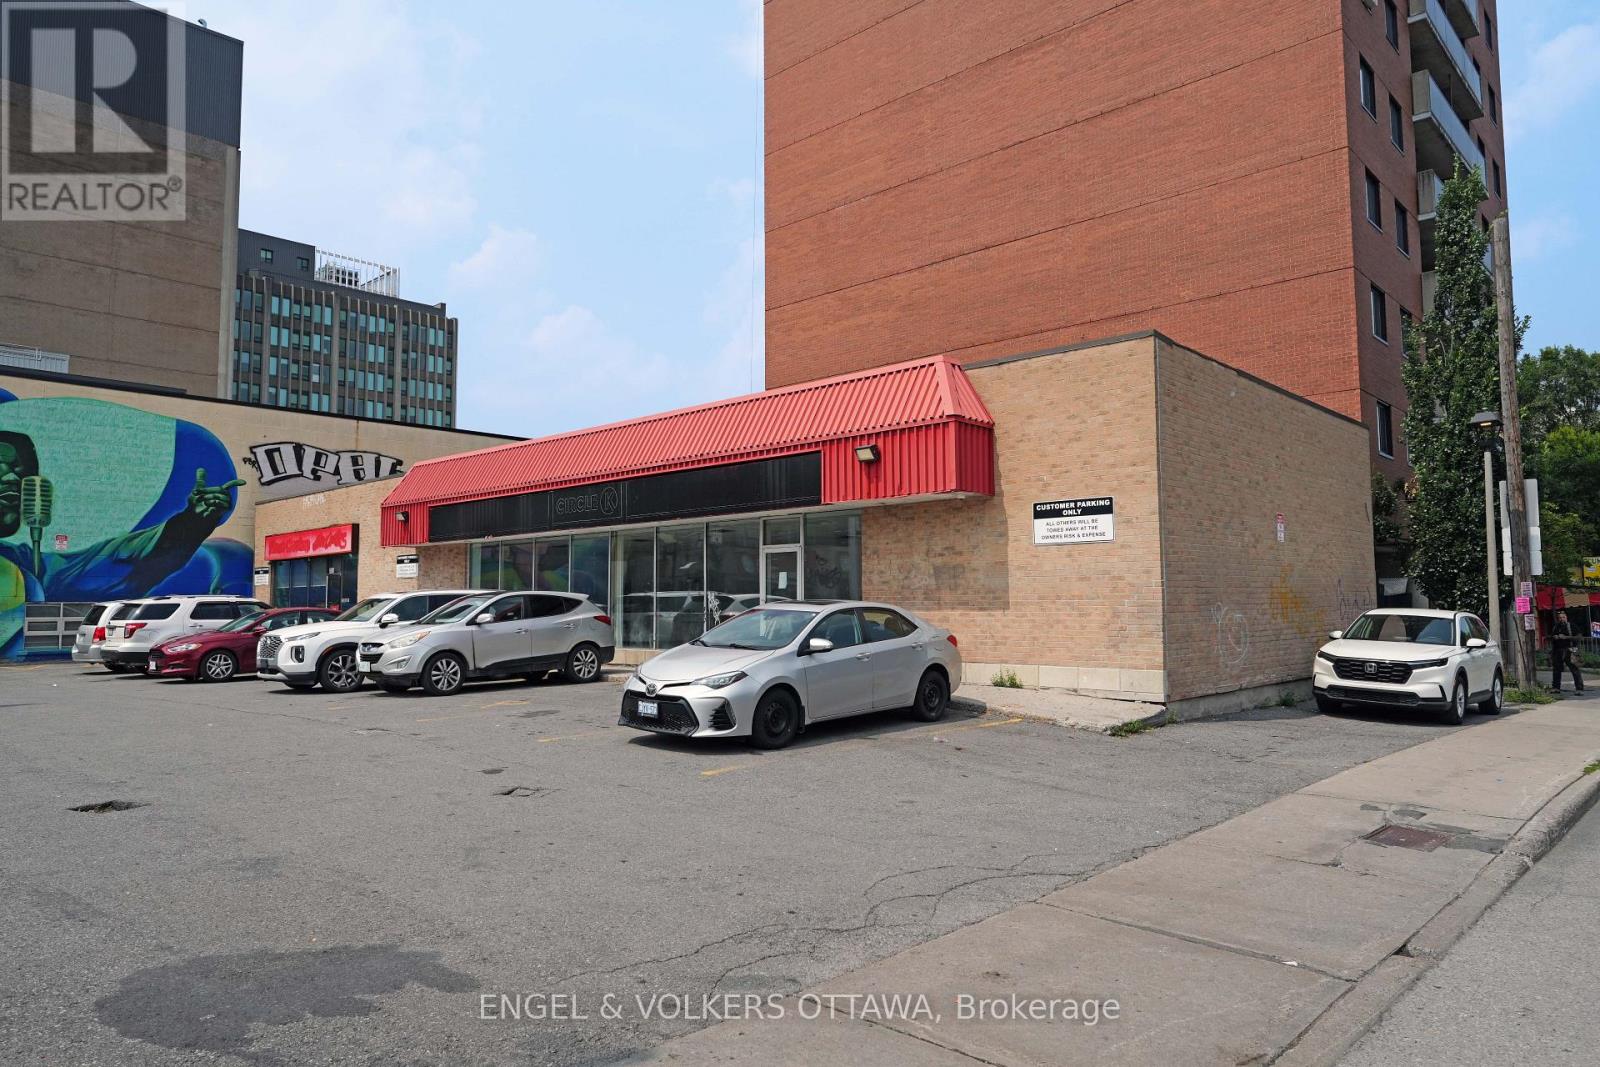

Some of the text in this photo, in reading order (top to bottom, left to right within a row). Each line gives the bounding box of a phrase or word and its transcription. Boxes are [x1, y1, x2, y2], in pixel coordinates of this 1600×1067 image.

[556, 493, 599, 514] CIRCLE
[1036, 499, 1110, 511] CUSTOMER PARKING
[1062, 508, 1082, 516] ONLY
